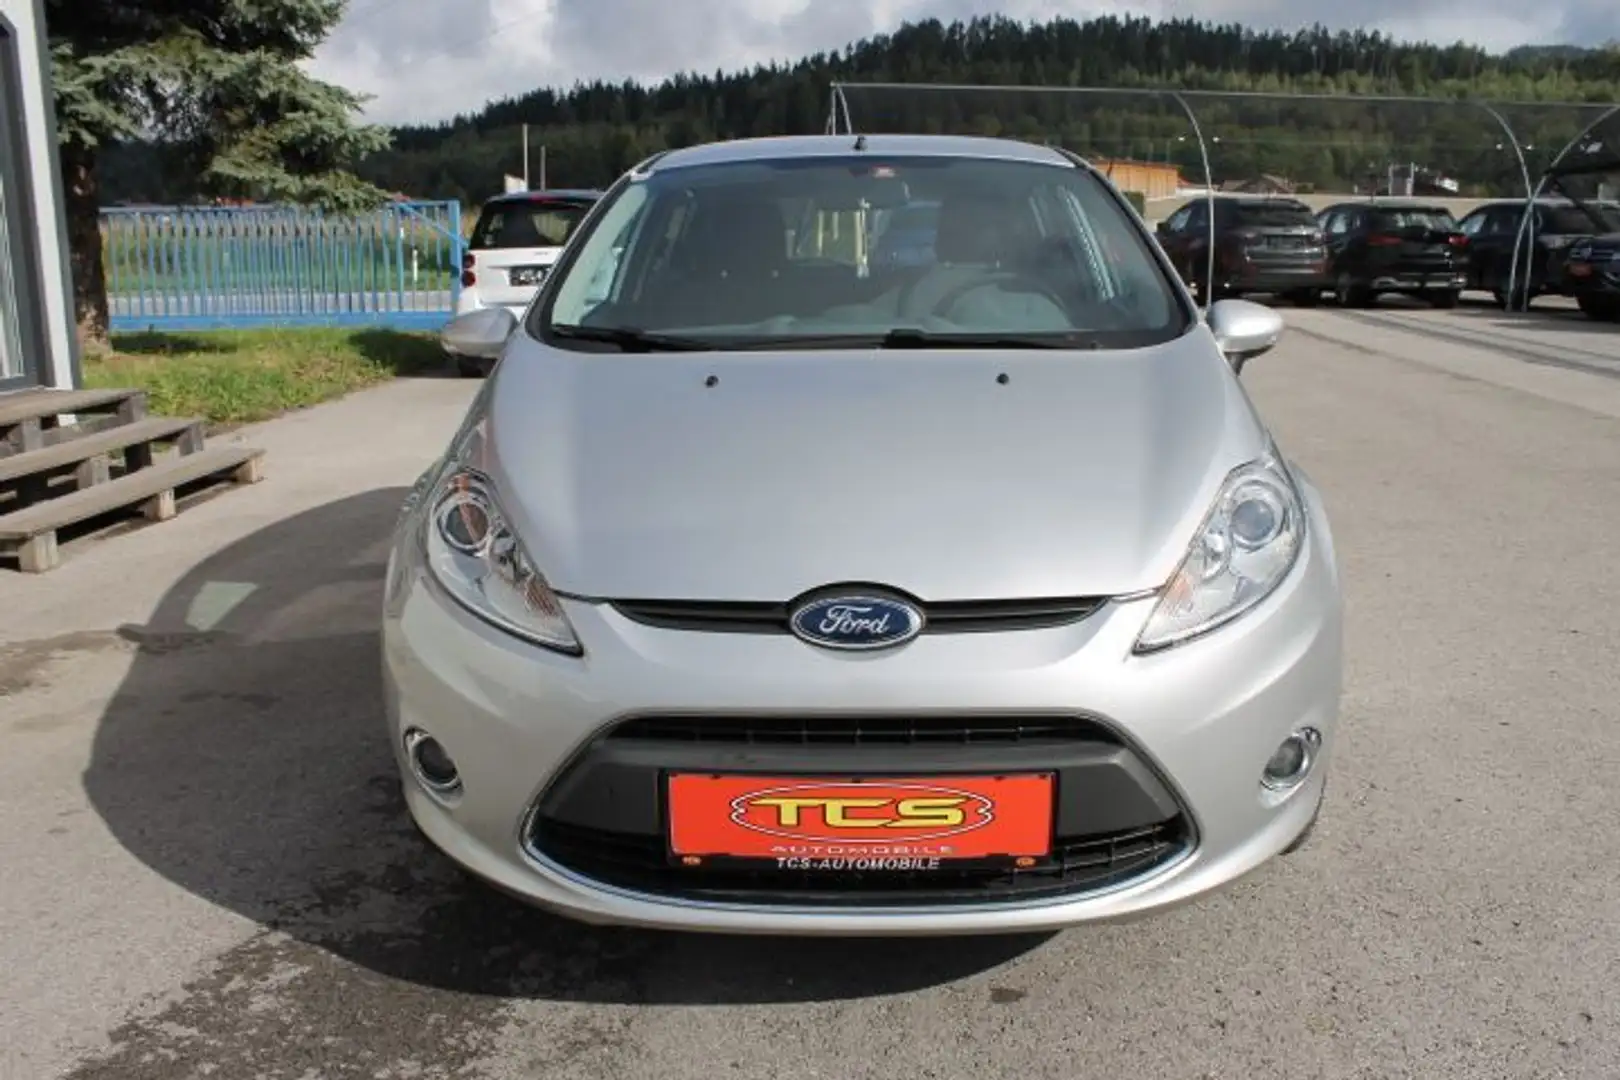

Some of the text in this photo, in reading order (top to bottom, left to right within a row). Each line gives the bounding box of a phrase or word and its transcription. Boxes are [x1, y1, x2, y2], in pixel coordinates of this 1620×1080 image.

[818, 604, 891, 635] Ford
[749, 796, 970, 828] TCS
[771, 845, 953, 854] AUTOMOBILE
[776, 857, 940, 870] TCS-AUTOMOBILE
